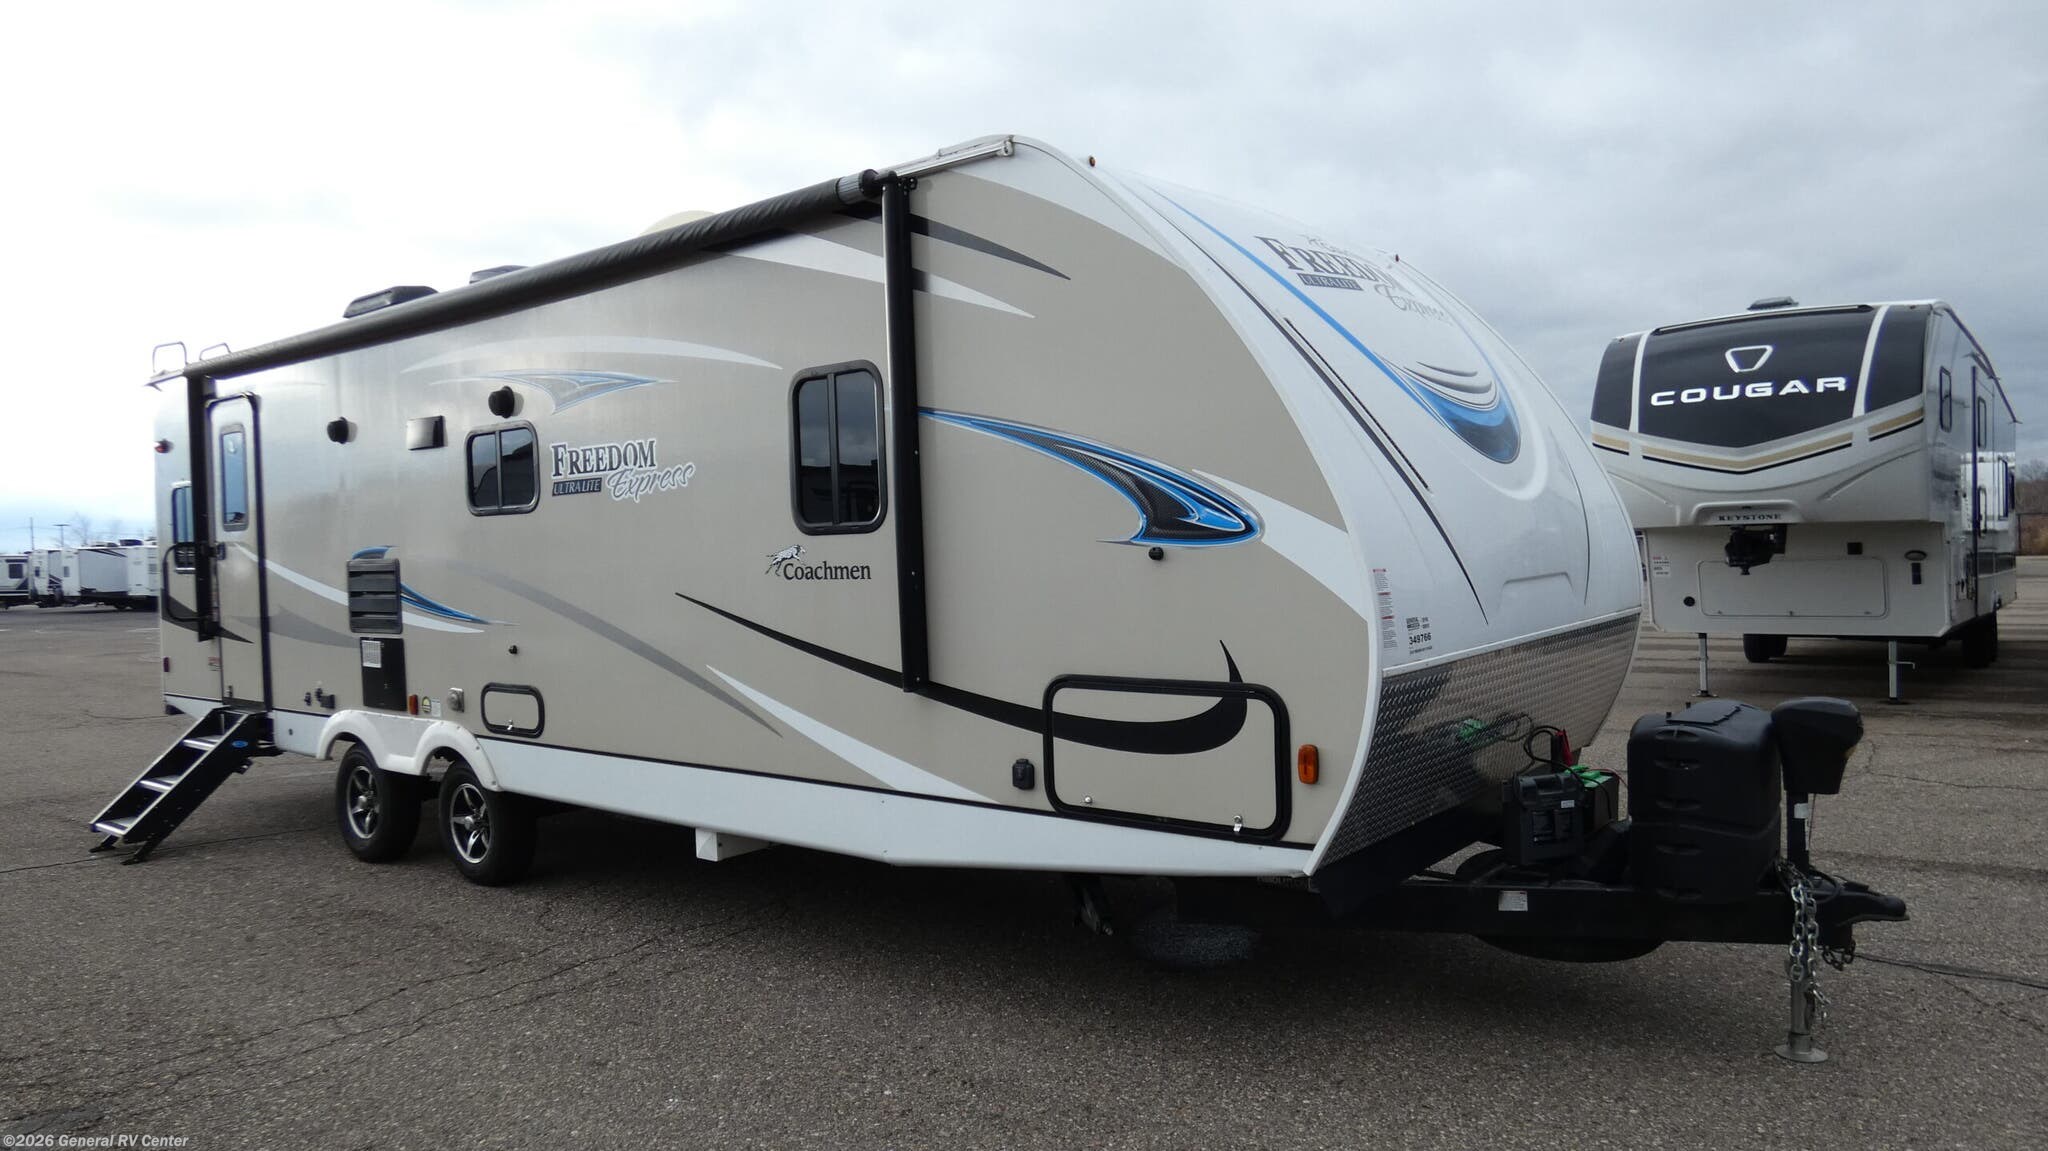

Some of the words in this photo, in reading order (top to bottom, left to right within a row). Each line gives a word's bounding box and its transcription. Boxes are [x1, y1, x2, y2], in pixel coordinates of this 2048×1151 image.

[1650, 376, 1847, 406] COUGAR
[552, 440, 656, 477] FREEDOM
[607, 464, 694, 501] Express
[1718, 513, 1782, 522] KEYSTONE
[783, 560, 872, 580] Coachmen
[1408, 632, 1432, 645] 349766
